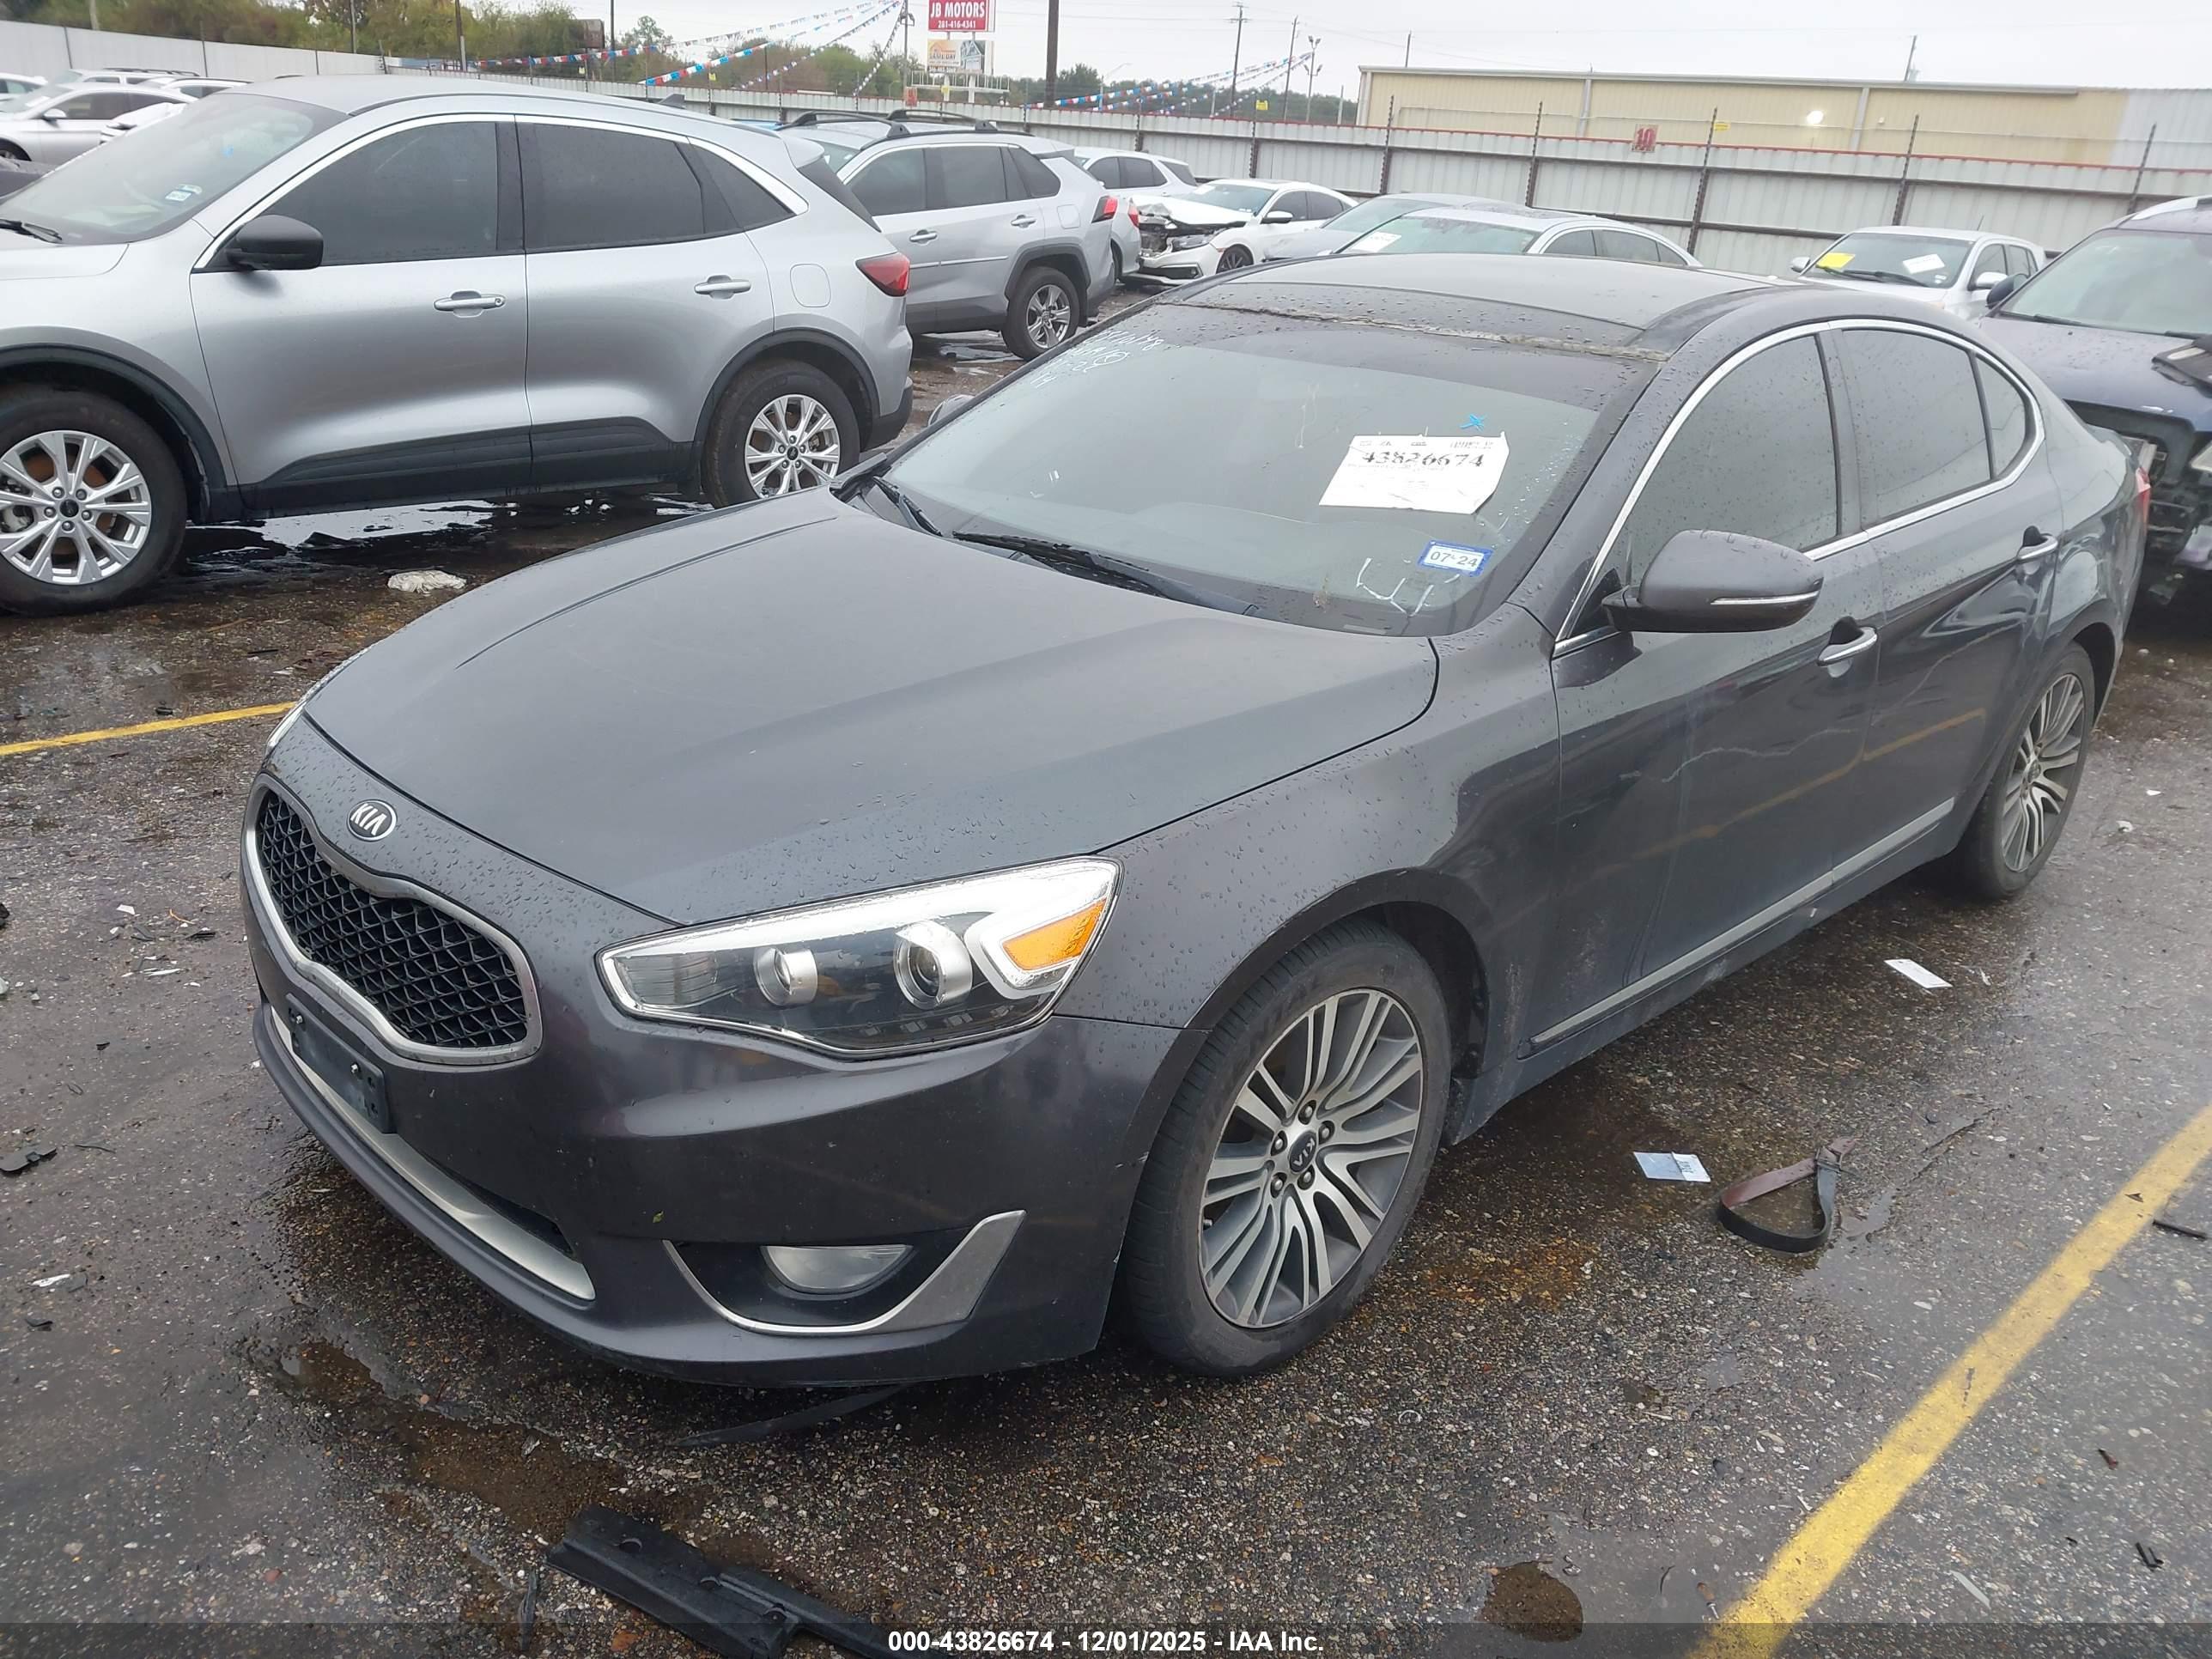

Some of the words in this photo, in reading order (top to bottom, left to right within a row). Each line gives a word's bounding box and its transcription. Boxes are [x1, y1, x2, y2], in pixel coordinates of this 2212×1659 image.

[931, 2, 941, 17] JB
[945, 2, 985, 17] MOTORS
[1637, 128, 1655, 147] 10
[1362, 451, 1485, 467] 43826674
[350, 803, 387, 836] KIA
[1293, 1138, 1316, 1166] KIA
